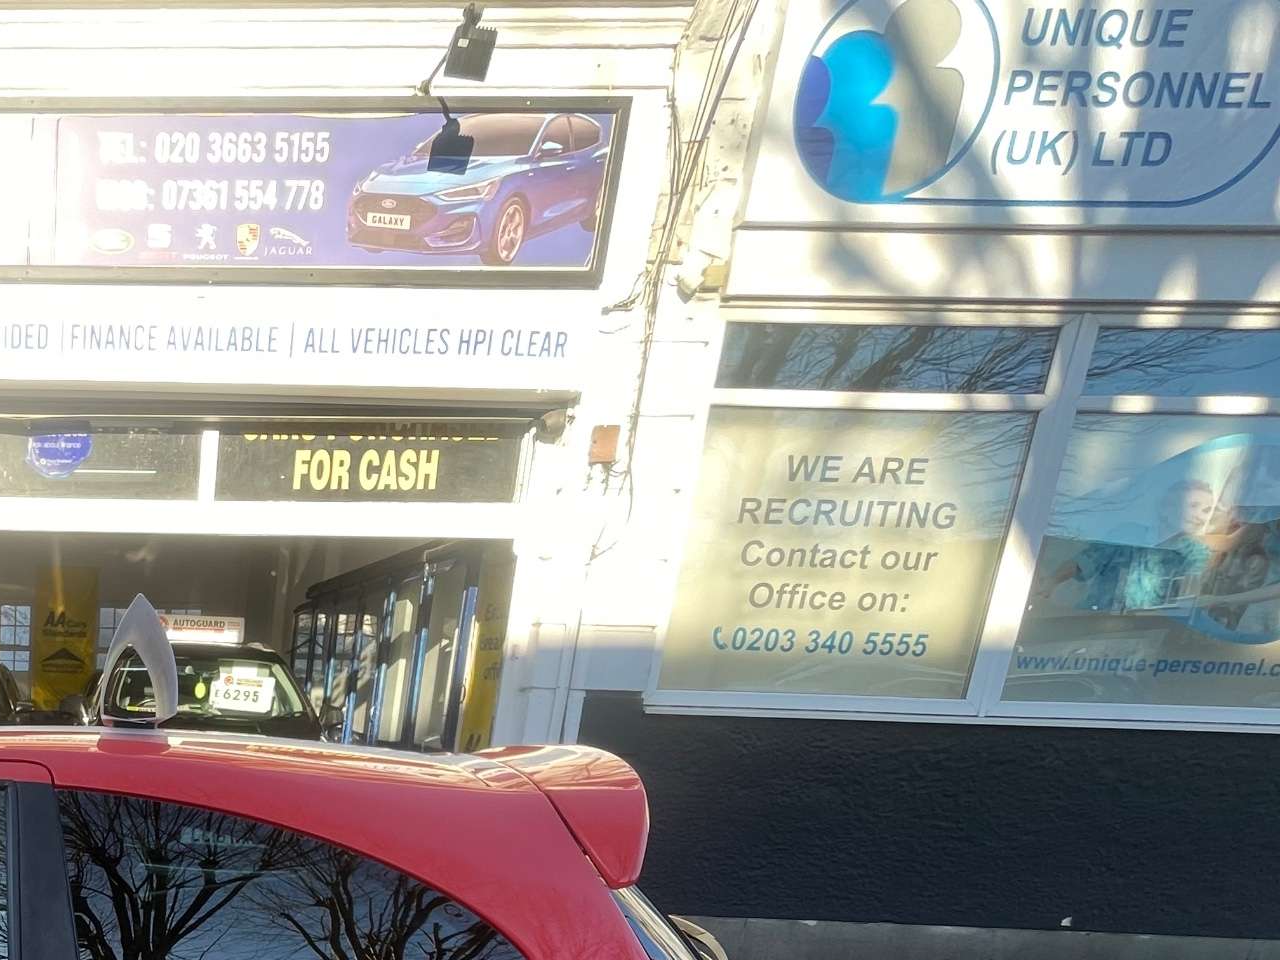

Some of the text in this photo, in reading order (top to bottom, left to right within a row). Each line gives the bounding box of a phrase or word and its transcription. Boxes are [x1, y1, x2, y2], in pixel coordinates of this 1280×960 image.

[1022, 8, 1193, 48] UNIQUE
[1004, 70, 1272, 109] PERSONNEL
[154, 132, 200, 163] 020
[206, 132, 267, 164] 3663
[274, 131, 330, 163] 5155
[991, 130, 1173, 175] (UK) LTD
[234, 179, 277, 211] 554
[284, 179, 325, 211] 778
[371, 215, 404, 227] GALAXY
[264, 247, 313, 256] JAGUAR
[71, 324, 279, 353] FINANCE AVAILABLE
[303, 327, 569, 358] ALL VEHICLES HPI CLEAR
[292, 449, 440, 491] FOR CASH
[787, 455, 929, 485] WE ARE
[737, 497, 957, 529] RECRUITING
[741, 540, 938, 571] Contact our
[749, 582, 910, 612] Office on:
[173, 619, 226, 628] AUTOGUARD
[731, 627, 929, 657] 0203 340 5555
